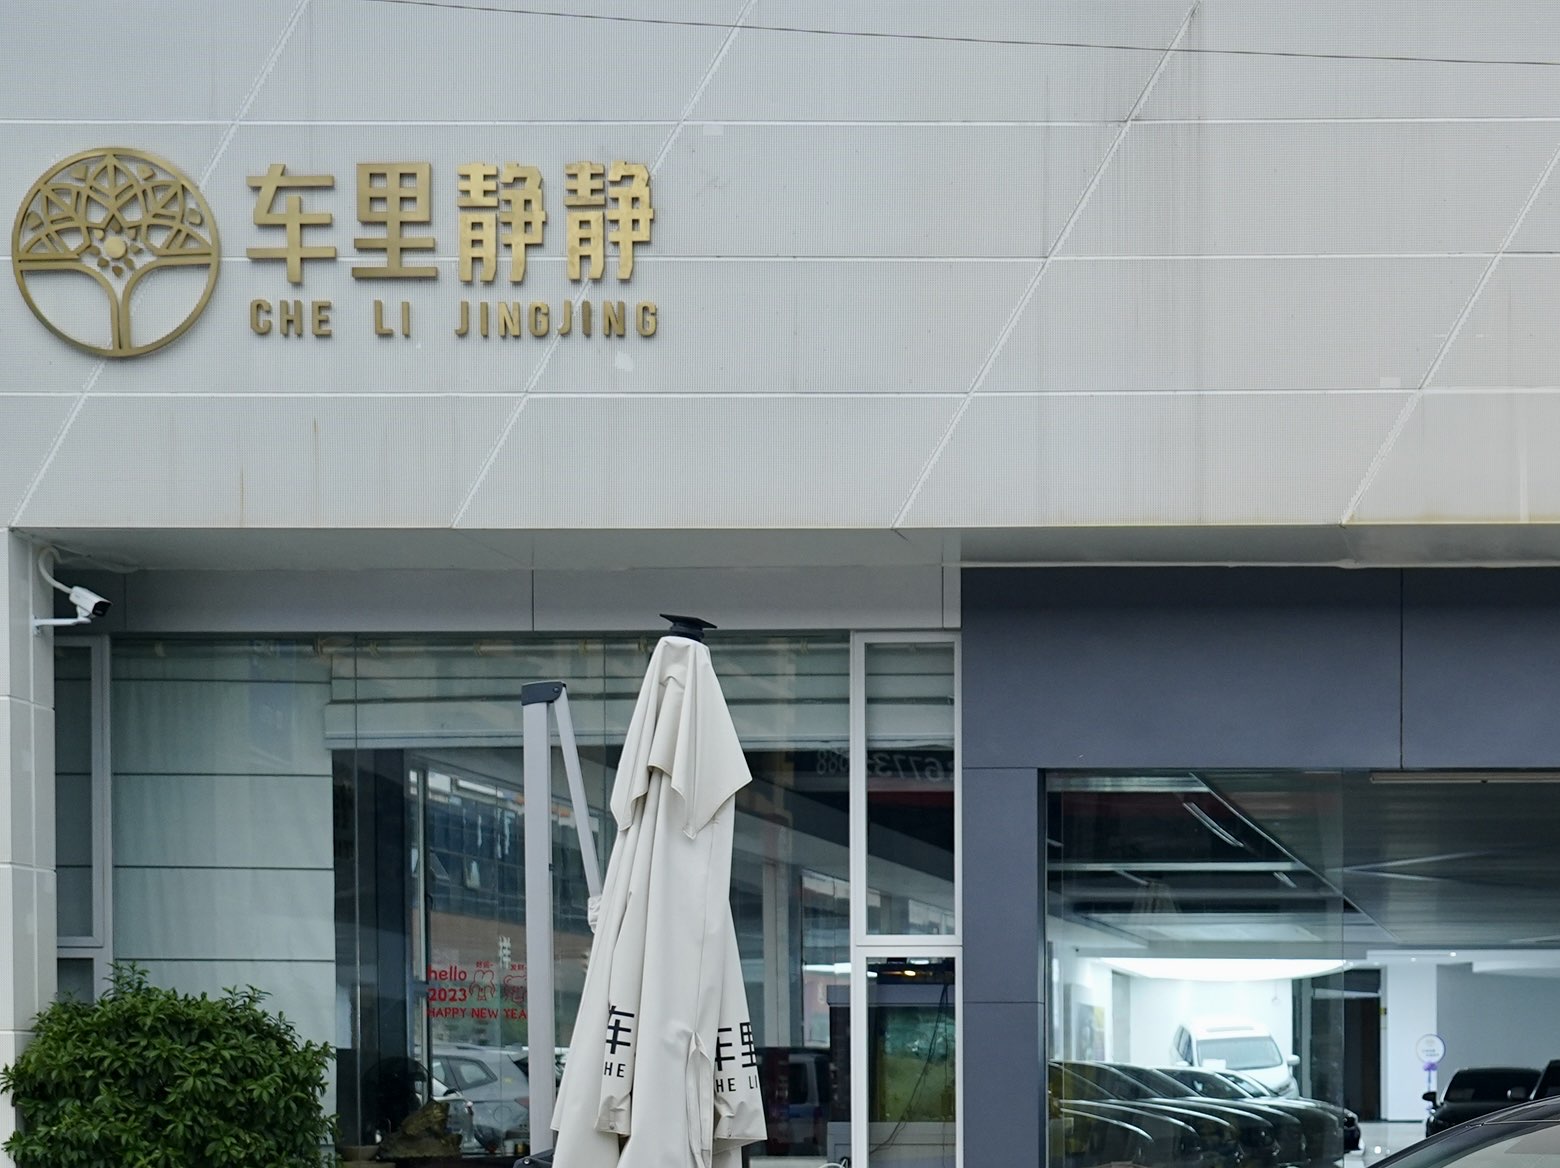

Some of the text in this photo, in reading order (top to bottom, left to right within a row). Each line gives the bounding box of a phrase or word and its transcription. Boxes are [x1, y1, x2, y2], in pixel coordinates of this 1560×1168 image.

[246, 160, 655, 285] 车里静静
[249, 299, 332, 337] CHE
[374, 300, 411, 337] LI
[427, 964, 467, 981] hello
[427, 988, 467, 1002] 2023
[427, 1007, 527, 1019] HAPPY NEW YEA
[603, 1061, 626, 1078] HE
[715, 1078, 737, 1093] HE
